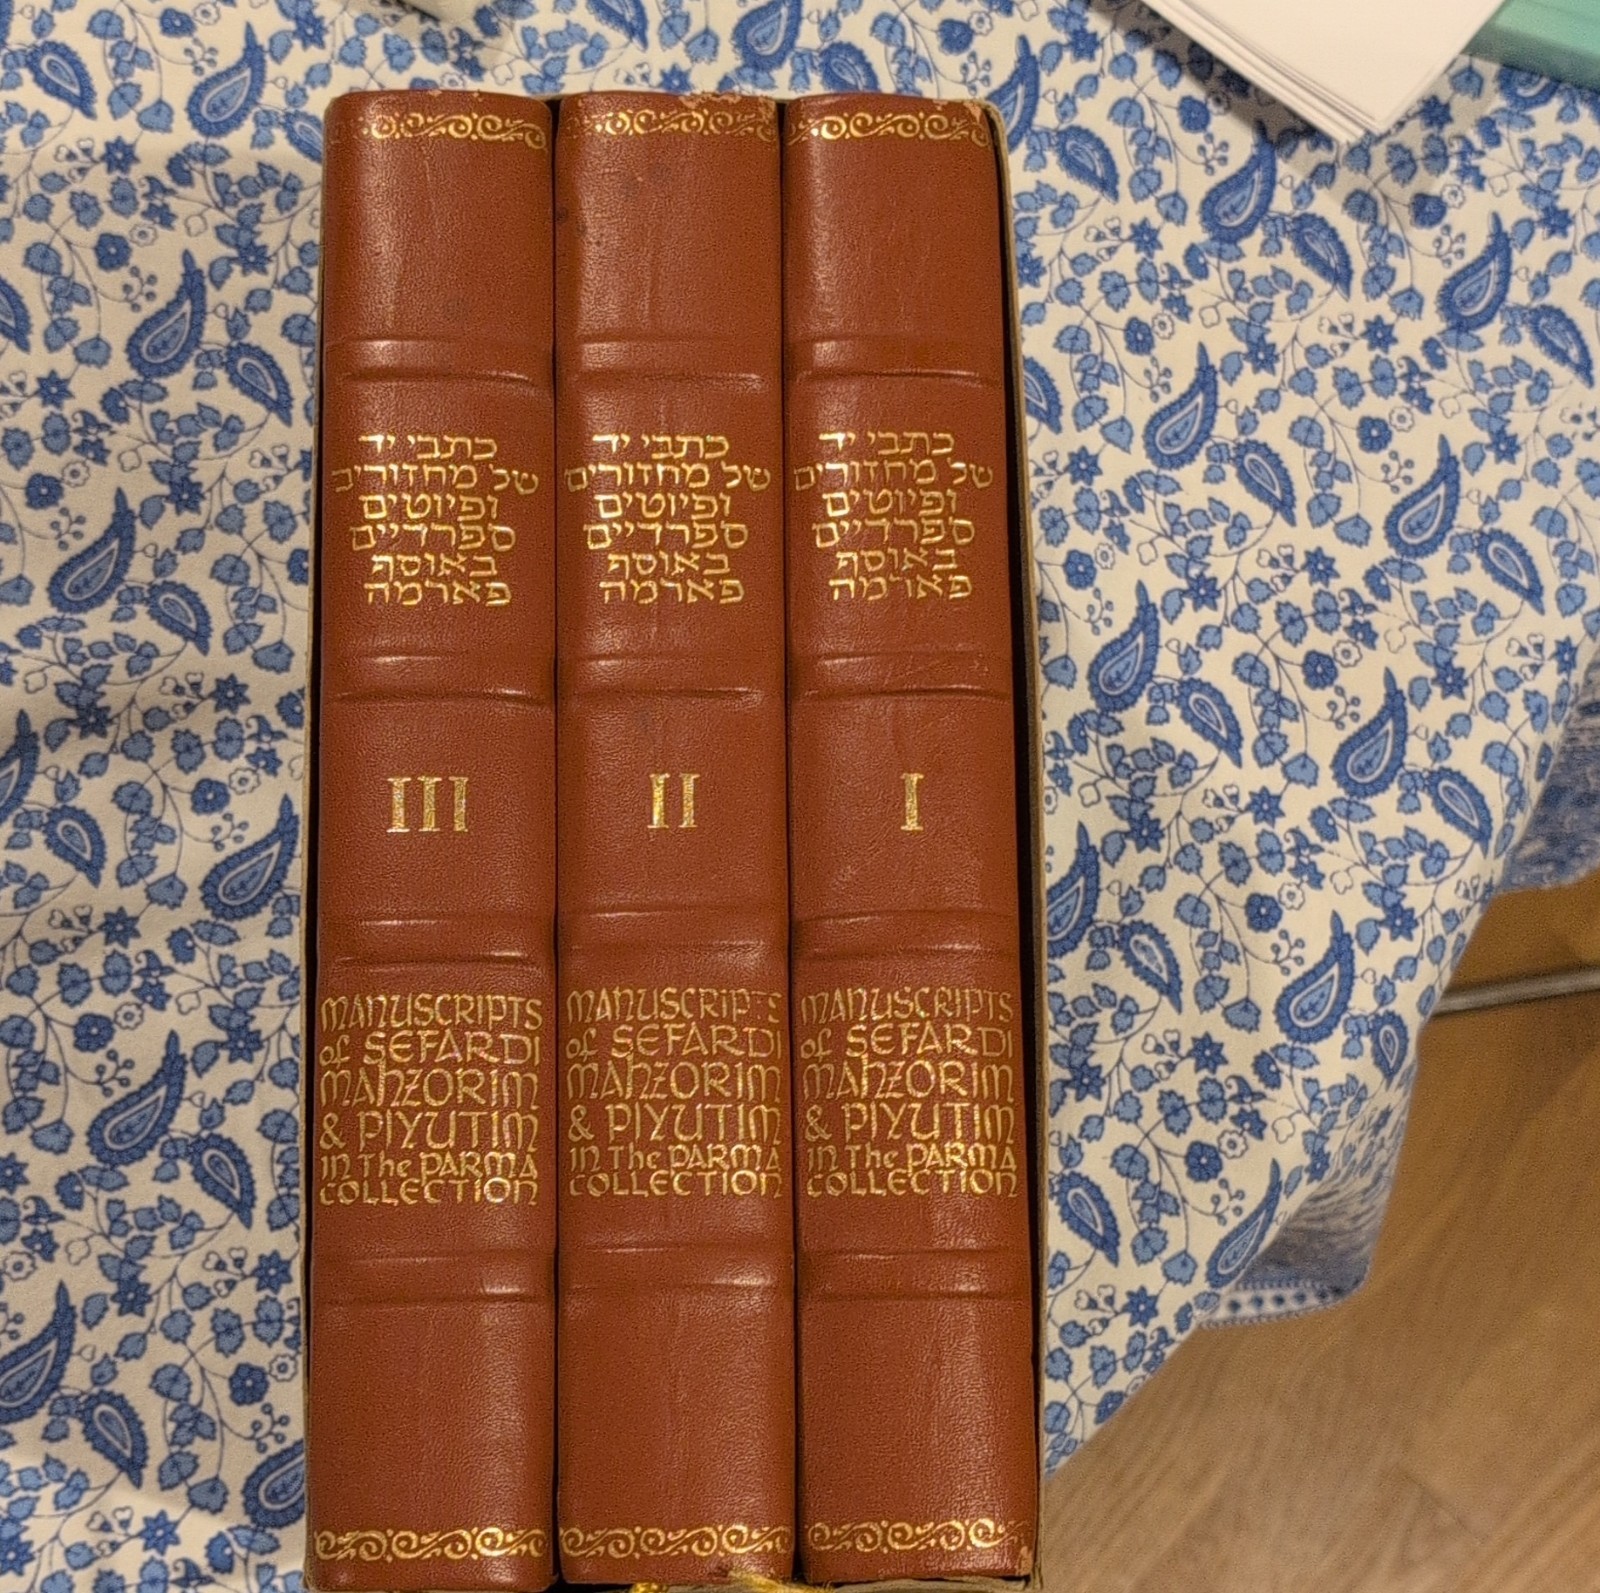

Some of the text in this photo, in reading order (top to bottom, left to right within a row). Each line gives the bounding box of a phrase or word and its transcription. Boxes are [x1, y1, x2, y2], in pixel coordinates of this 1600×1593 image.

[358, 434, 498, 460] כתבי יד
[592, 433, 730, 460] כתבי יד
[818, 431, 955, 456] כתבי יד
[488, 464, 539, 495] של
[564, 461, 771, 492] של מחזורים
[793, 457, 994, 491] של מחזורים
[358, 493, 499, 522] ופיוטים
[593, 491, 731, 520] ופיוטים
[822, 488, 957, 518] ופיוטים
[350, 522, 516, 552] ספרדיים
[583, 520, 749, 550] ספרדיים
[811, 516, 975, 548] ספרדיים
[371, 552, 498, 582] באוסף
[607, 550, 731, 580] באוסף
[835, 547, 958, 577] באוסף
[363, 580, 512, 607] פארמה
[599, 577, 745, 605] פארמה
[828, 574, 973, 601] פארמה
[386, 775, 470, 833] III
[646, 772, 701, 829] II
[900, 772, 925, 831] I
[319, 1028, 540, 1069] of SEFARDI
[566, 1021, 782, 1062] of SEFARDI
[800, 1021, 1013, 1062] of SEFARDI
[319, 1112, 347, 1150] &
[568, 1105, 595, 1142] &
[805, 1105, 832, 1142] &
[419, 1150, 539, 1186] PARMA
[668, 1144, 782, 1177] PARMA
[907, 1142, 1017, 1177] PARMA
